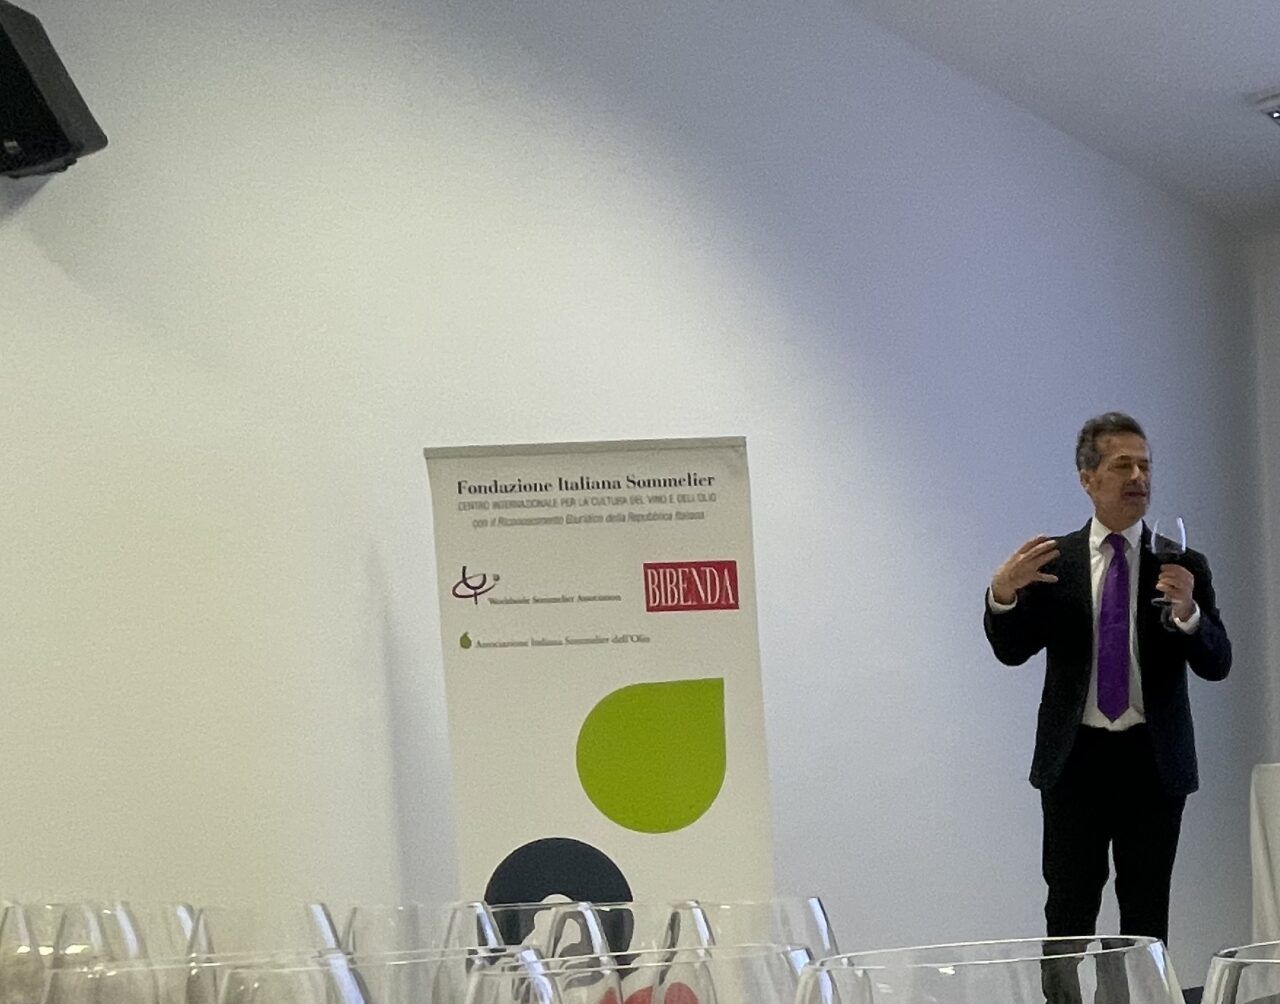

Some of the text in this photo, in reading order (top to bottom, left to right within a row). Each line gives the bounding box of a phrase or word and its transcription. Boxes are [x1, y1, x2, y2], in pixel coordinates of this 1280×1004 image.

[457, 471, 715, 494] Fondazione Italiana Sommelier
[560, 497, 577, 507] PER
[579, 497, 590, 507] LA
[590, 496, 627, 507] CULTURA
[629, 494, 644, 505] DEL
[646, 493, 667, 504] VINO
[647, 566, 736, 607] BIBENDA
